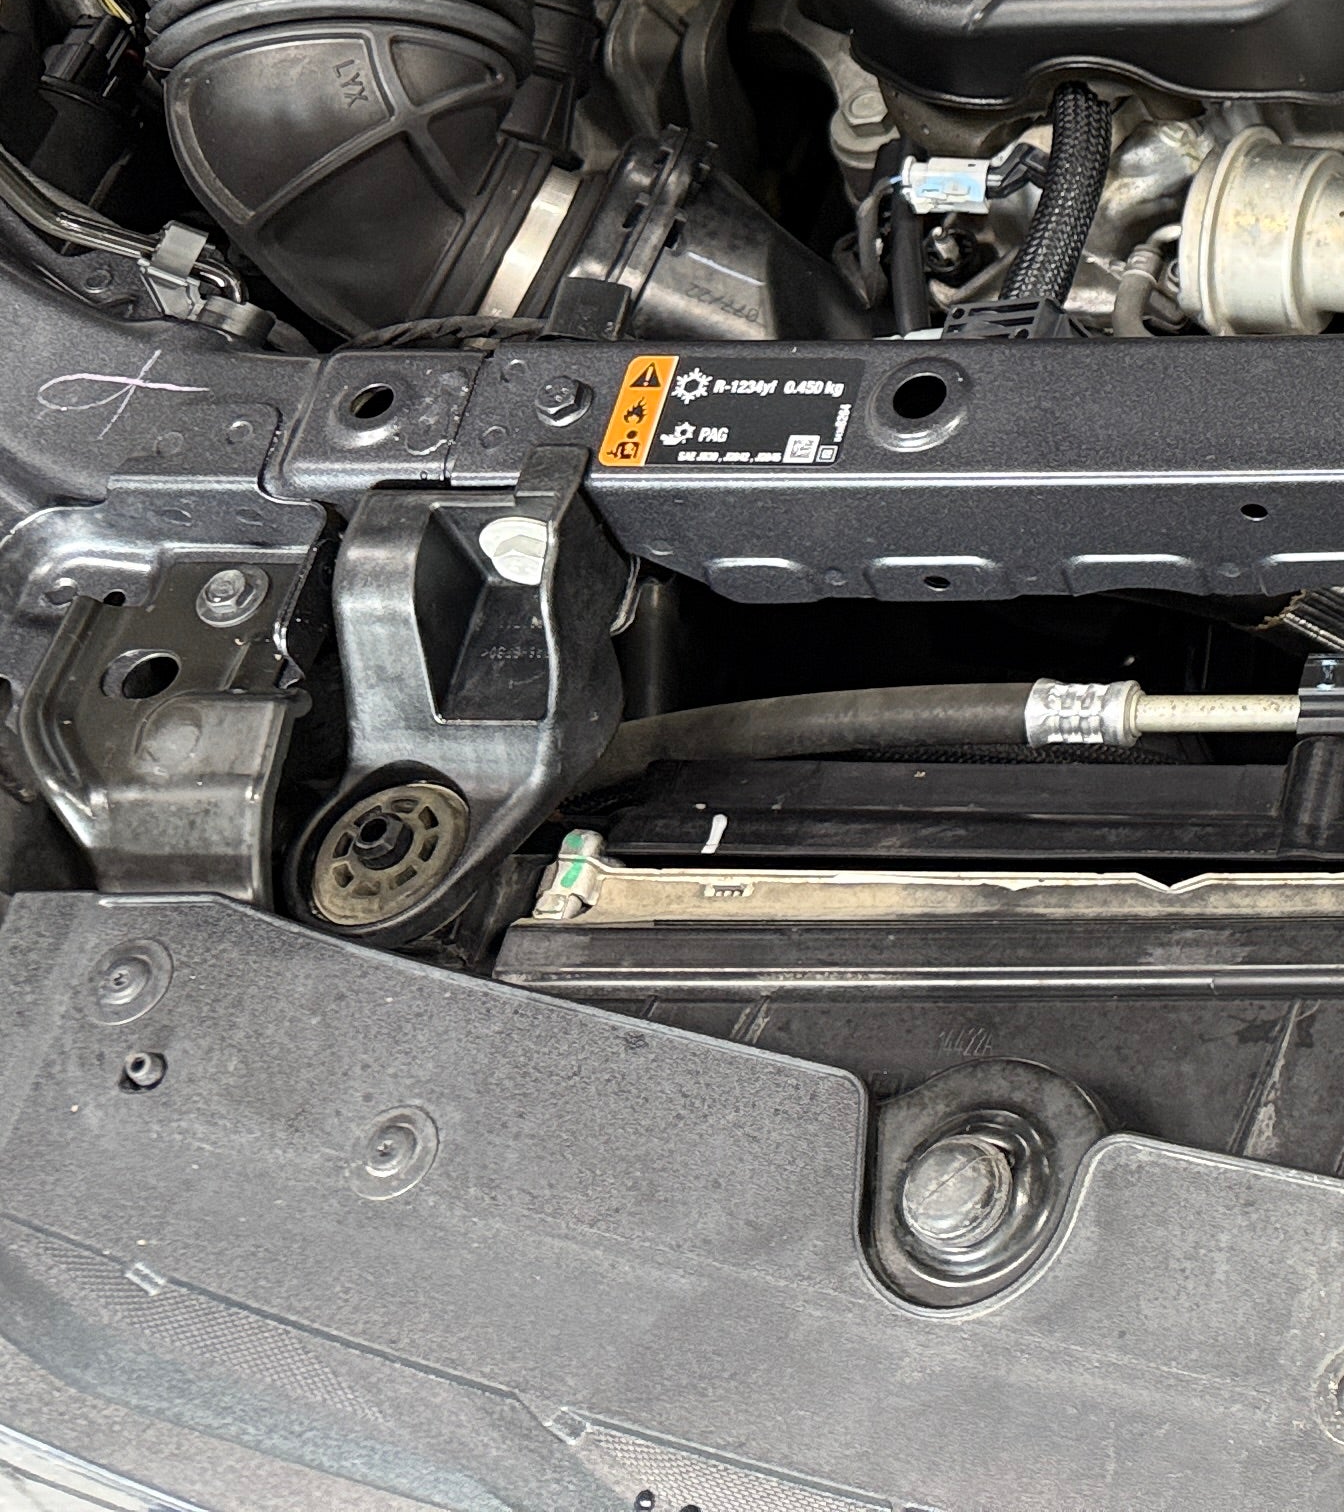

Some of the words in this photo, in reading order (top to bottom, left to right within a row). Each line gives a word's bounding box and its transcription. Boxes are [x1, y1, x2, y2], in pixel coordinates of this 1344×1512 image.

[333, 58, 369, 109] LYX
[713, 378, 778, 396] R-1234yf
[783, 380, 825, 396] 0.450
[824, 381, 846, 398] kg
[698, 426, 730, 443] PAG
